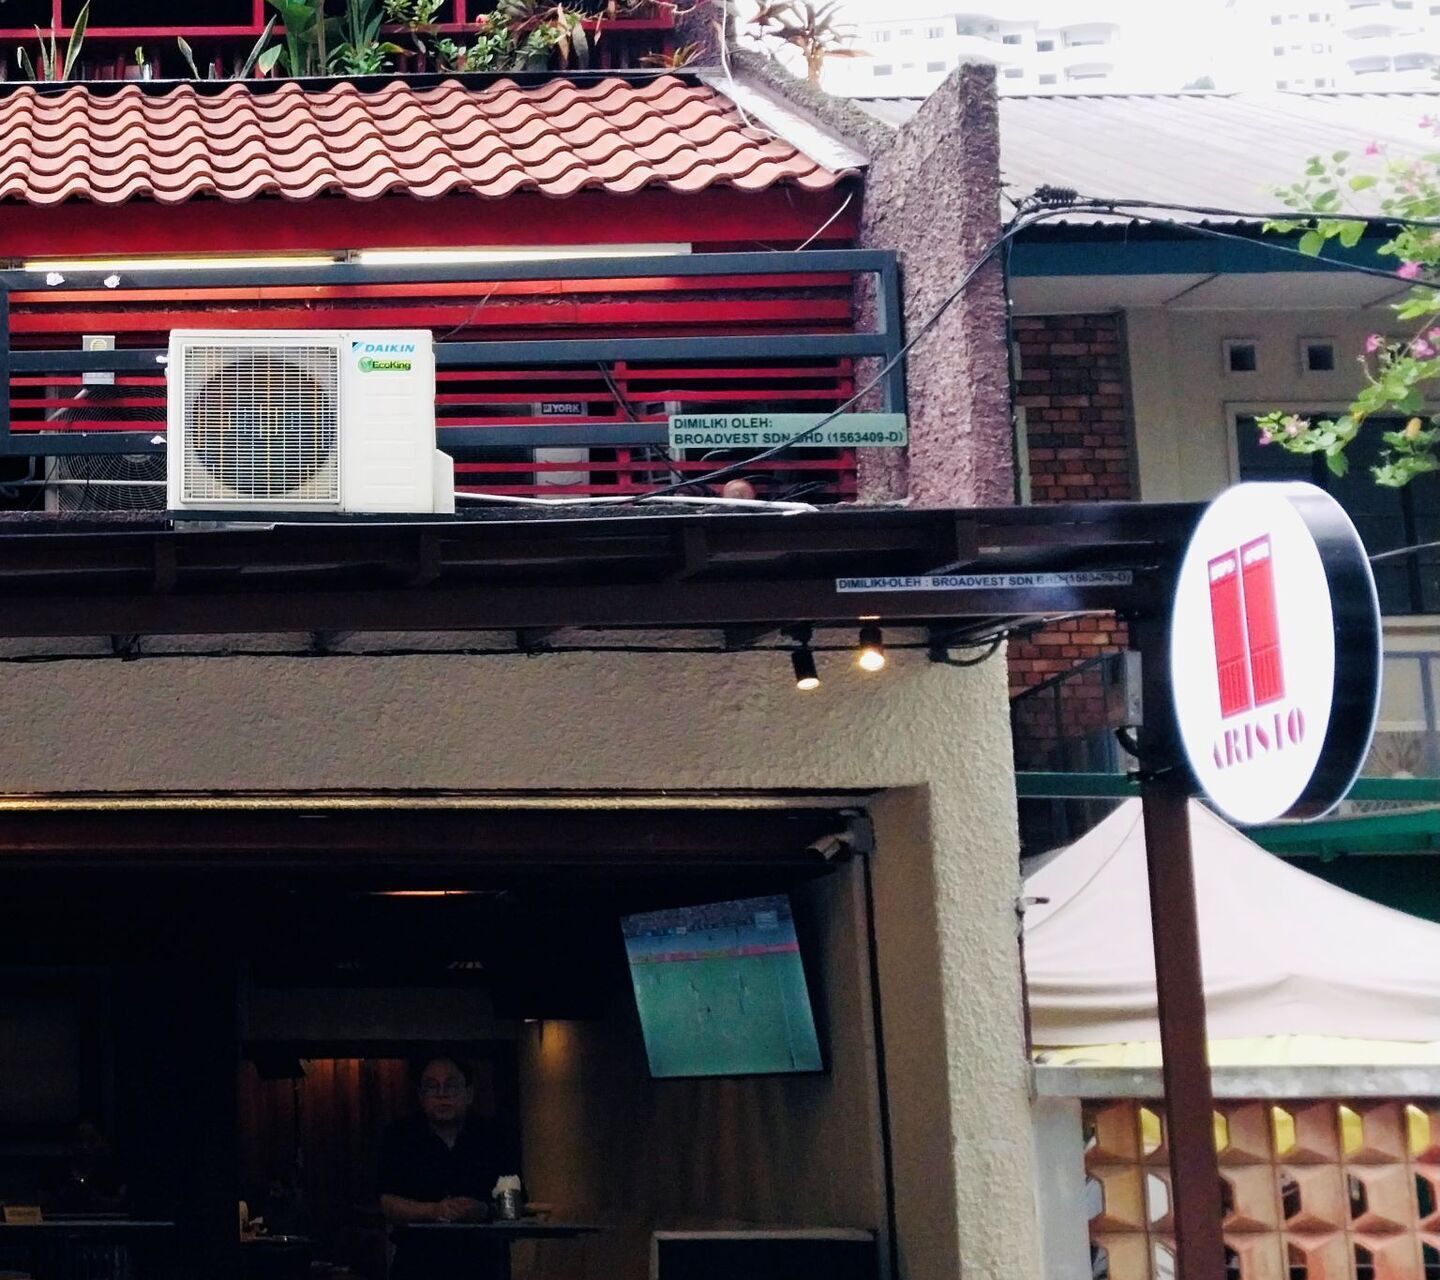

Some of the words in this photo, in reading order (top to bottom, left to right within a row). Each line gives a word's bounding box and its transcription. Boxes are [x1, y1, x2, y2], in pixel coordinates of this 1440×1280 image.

[365, 344, 415, 353] DAIKIN
[372, 360, 411, 370] EcoKing
[552, 403, 581, 413] YORK
[673, 418, 728, 430] DIMILIKI
[730, 417, 773, 429] OLEH:
[674, 433, 758, 445] BROADVEST
[762, 432, 790, 444] SDN
[932, 576, 1006, 586] BROADVEST
[1008, 575, 1033, 586] SDN
